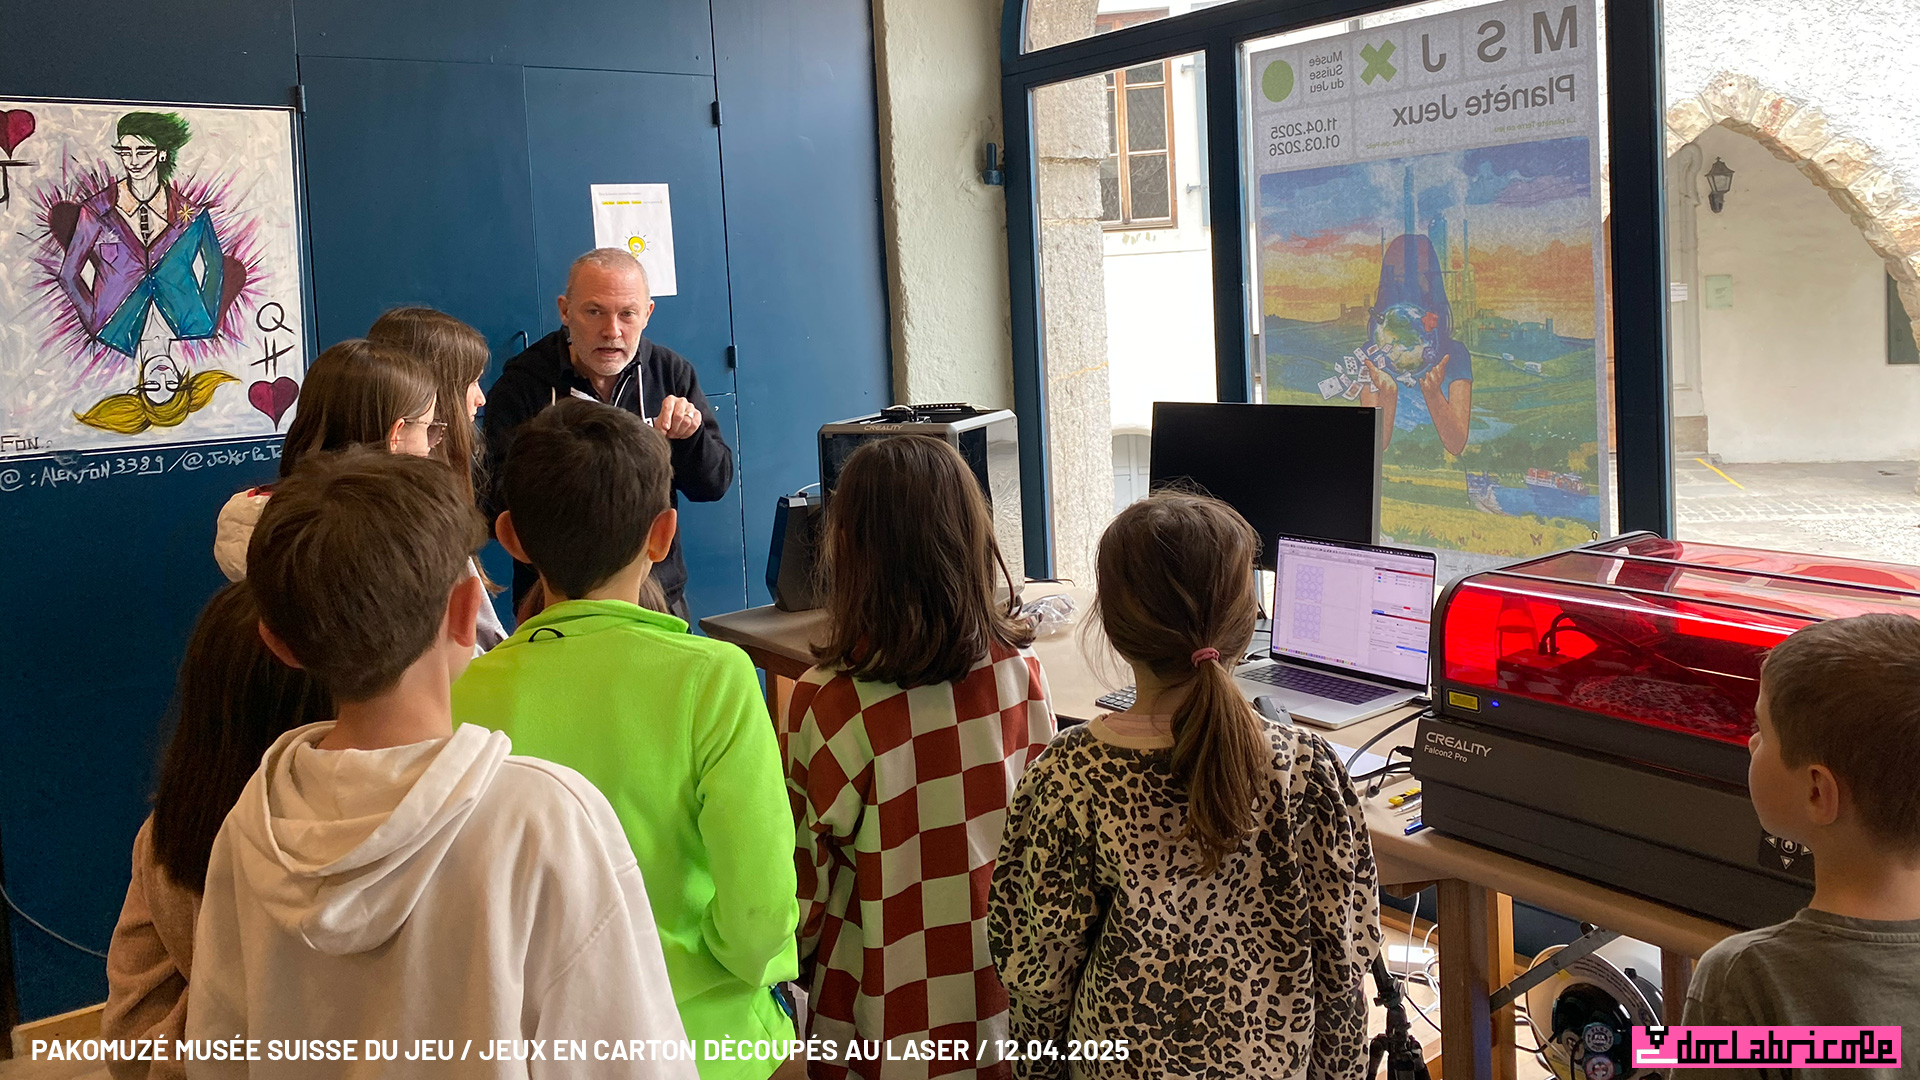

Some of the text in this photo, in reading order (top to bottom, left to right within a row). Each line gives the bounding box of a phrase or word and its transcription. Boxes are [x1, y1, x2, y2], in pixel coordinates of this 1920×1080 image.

[256, 302, 296, 335] Q
[1424, 745, 1468, 763] Falcon2 Pro
[1426, 732, 1492, 757] CREALITY
